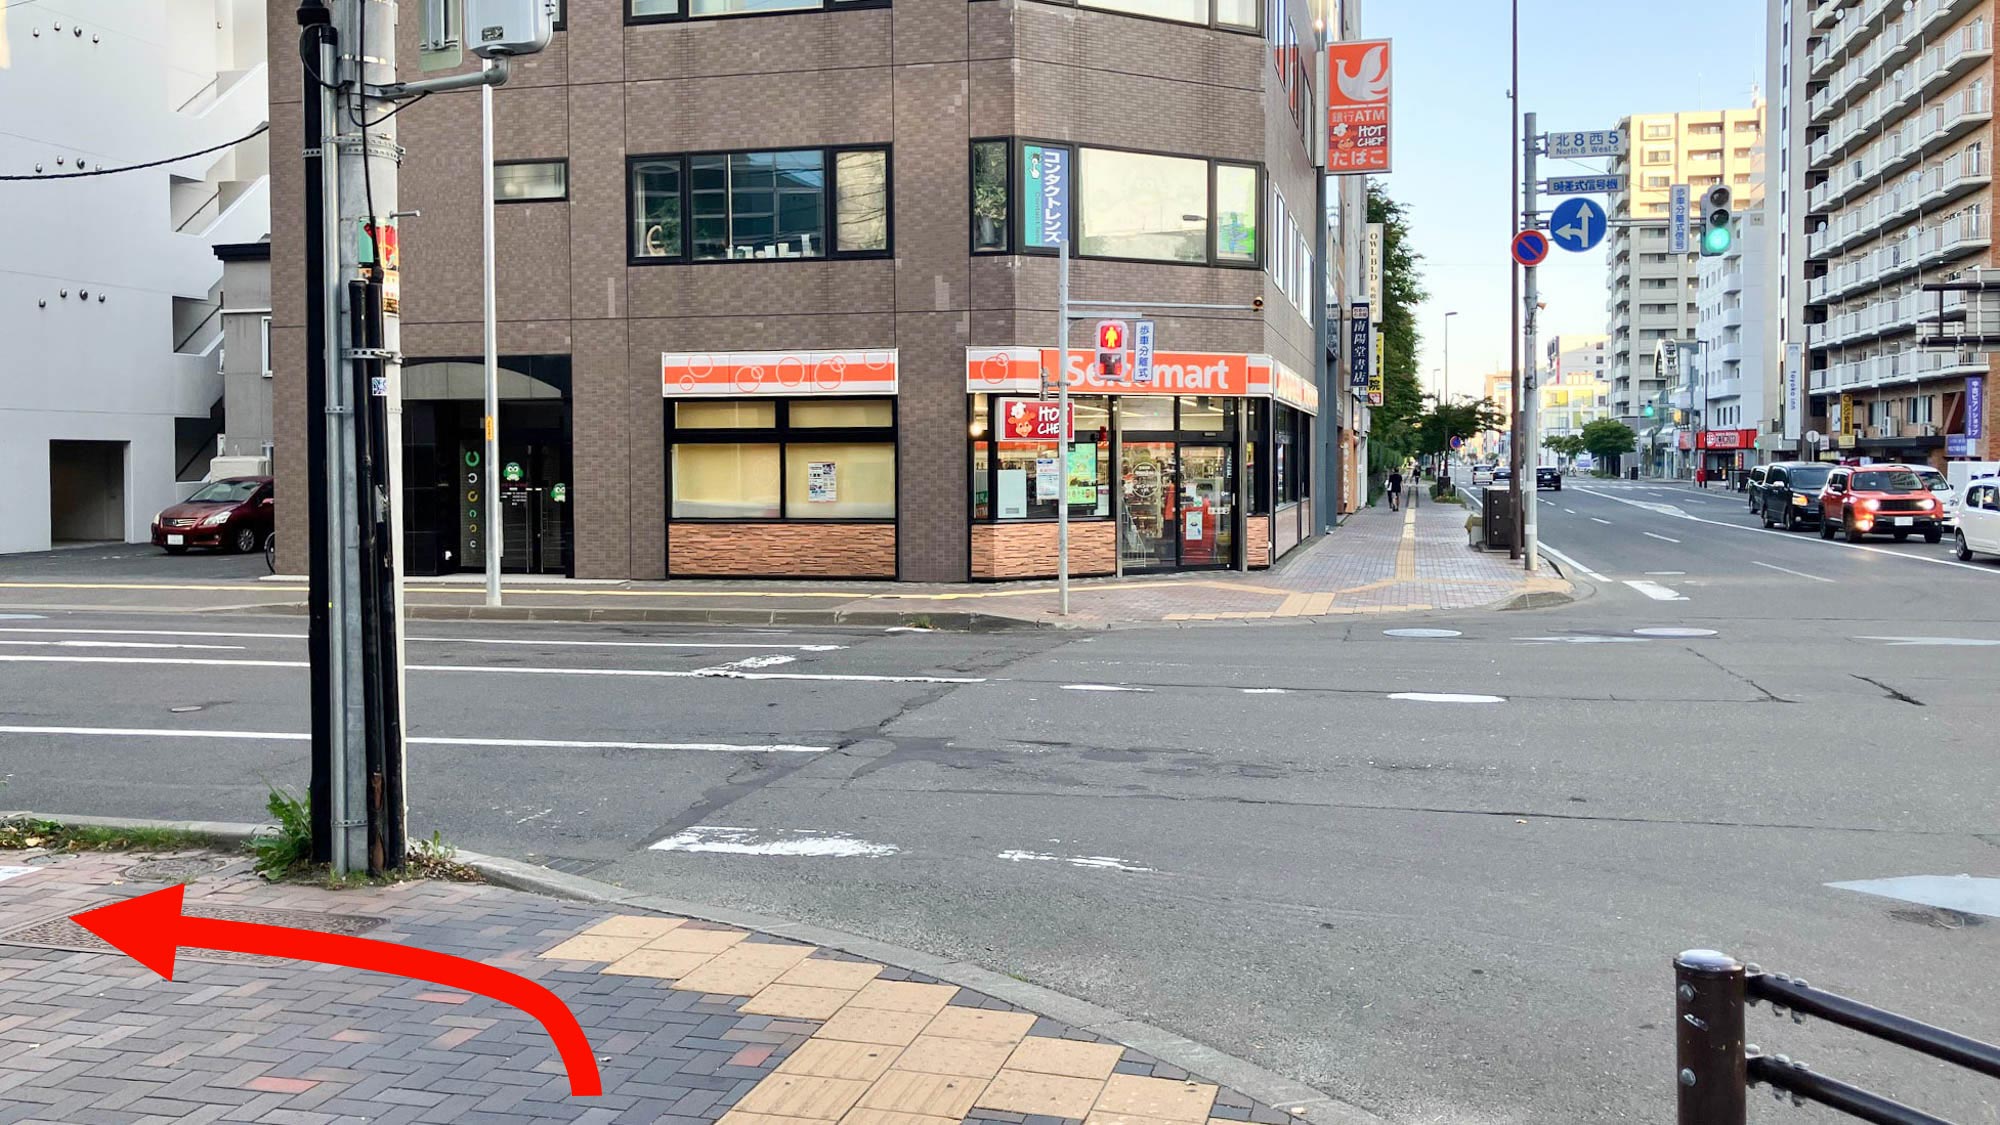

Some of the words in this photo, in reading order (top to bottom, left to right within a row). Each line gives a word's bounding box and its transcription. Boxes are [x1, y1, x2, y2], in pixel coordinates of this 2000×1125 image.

[1358, 125, 1386, 137] HOT
[1357, 136, 1385, 147] CHEF
[1556, 147, 1579, 155] North
[1591, 145, 1611, 153] West
[1332, 149, 1384, 166] たばこ
[1044, 151, 1062, 243] コンタクトレンズ
[1138, 325, 1150, 378] 歩車分離式
[1037, 423, 1069, 435] CHE
